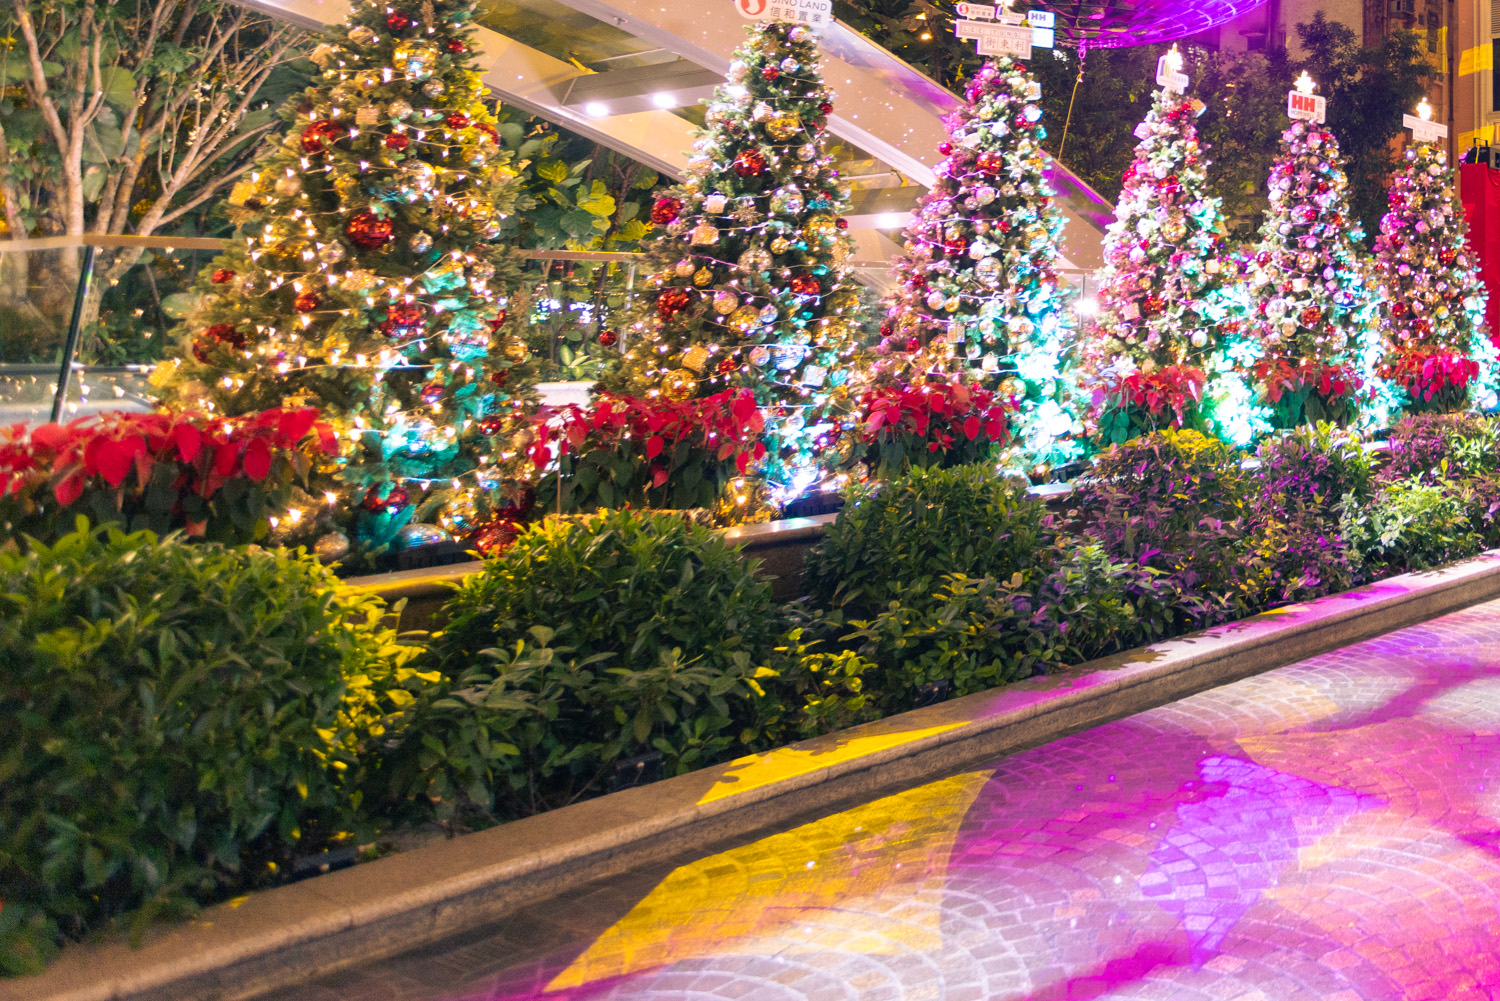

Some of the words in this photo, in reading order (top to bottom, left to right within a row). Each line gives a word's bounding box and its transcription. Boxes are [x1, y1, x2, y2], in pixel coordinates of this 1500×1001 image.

[799, 0, 827, 11] LAND
[1030, 12, 1046, 21] HH
[993, 29, 1019, 38] TUNG
[1291, 94, 1316, 113] HH
